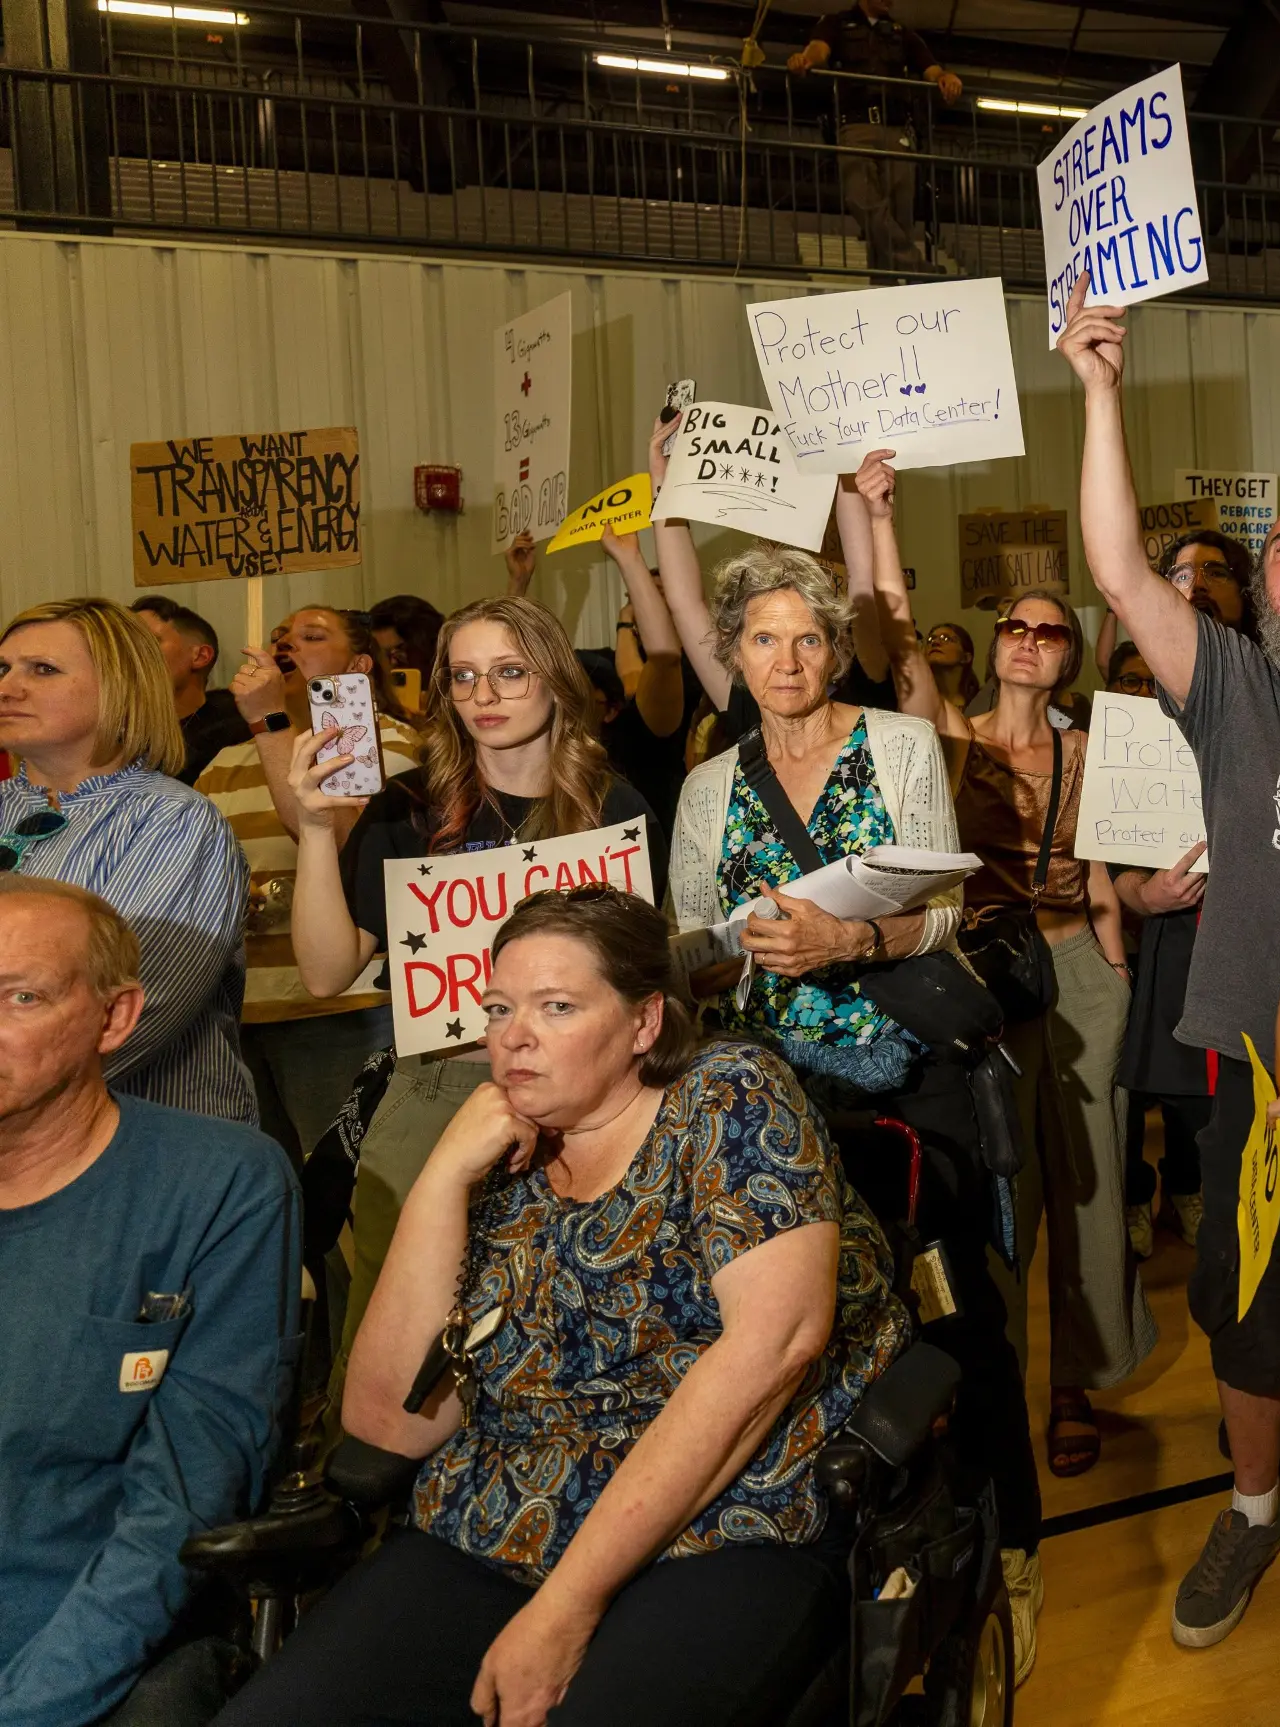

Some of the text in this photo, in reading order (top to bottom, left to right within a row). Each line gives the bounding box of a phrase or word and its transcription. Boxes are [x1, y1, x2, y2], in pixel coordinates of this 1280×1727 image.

[1054, 91, 1173, 211] STREAMS
[1069, 175, 1134, 247] OVER
[754, 308, 961, 365] Protect our
[778, 345, 921, 418] Mother!!
[504, 410, 521, 452] 13
[683, 407, 727, 434] BIG
[784, 389, 1001, 449] Fuck Your Data Center!
[166, 432, 307, 464] WE WANT
[688, 437, 781, 464] SMALL
[136, 452, 360, 517] TRANSPARENCY
[581, 489, 633, 521] NO
[1186, 475, 1271, 498] THEY GET
[495, 471, 567, 542] BAD AIR
[569, 509, 643, 537] DATA CENTER
[1220, 505, 1273, 519] REBATES
[139, 517, 256, 567] WATER
[276, 502, 361, 555] ENERGY
[965, 518, 1062, 546] SAVE THE
[961, 549, 1068, 591] GREAT SALT LAKE
[1095, 819, 1207, 843] Protect ou
[407, 872, 508, 934] YOU
